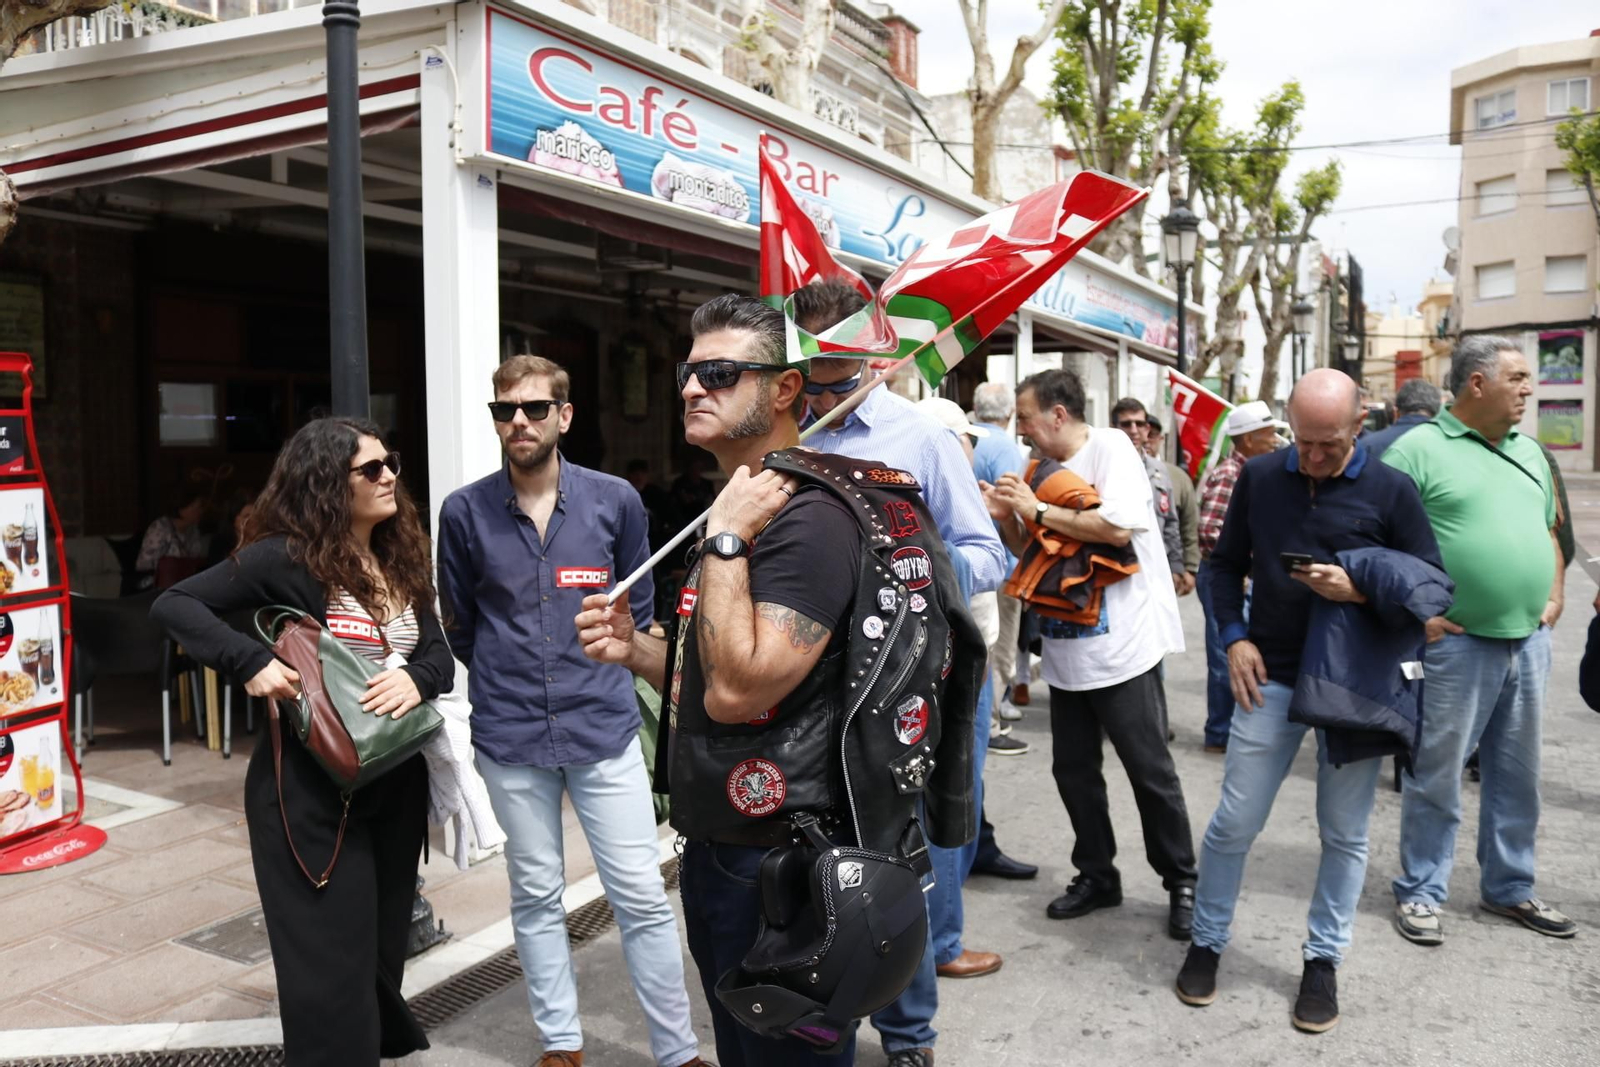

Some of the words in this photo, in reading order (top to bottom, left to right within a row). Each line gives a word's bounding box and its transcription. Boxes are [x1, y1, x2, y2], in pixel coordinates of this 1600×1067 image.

[529, 47, 697, 149] Café
[765, 133, 840, 198] Bar
[536, 128, 613, 170] marisco
[668, 170, 750, 212] montaditos
[883, 501, 921, 537] 13
[756, 761, 781, 782] ROCKERS
[775, 782, 783, 800] CLUB
[750, 802, 776, 814] MADRID
